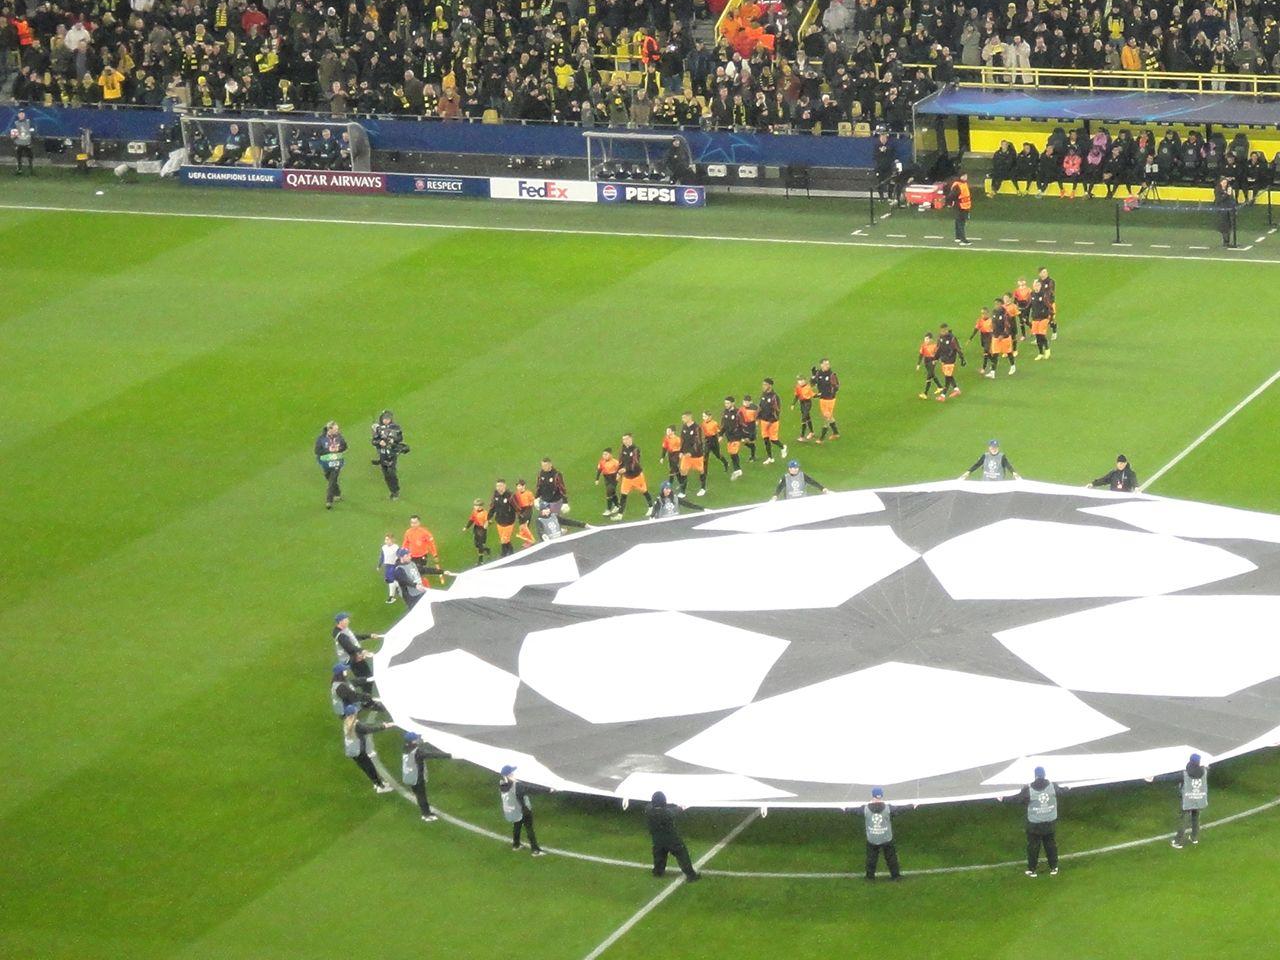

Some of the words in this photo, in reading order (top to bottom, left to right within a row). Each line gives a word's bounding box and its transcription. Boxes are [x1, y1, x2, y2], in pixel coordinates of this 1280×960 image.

[207, 172, 247, 181] CHAMPIONS
[247, 174, 274, 182] LEAGUE
[286, 173, 328, 187] QATAR
[330, 175, 382, 188] AIRWAYS
[427, 180, 463, 191] RESPECT
[518, 181, 568, 198] FedEx
[625, 187, 676, 202] PEPSI
